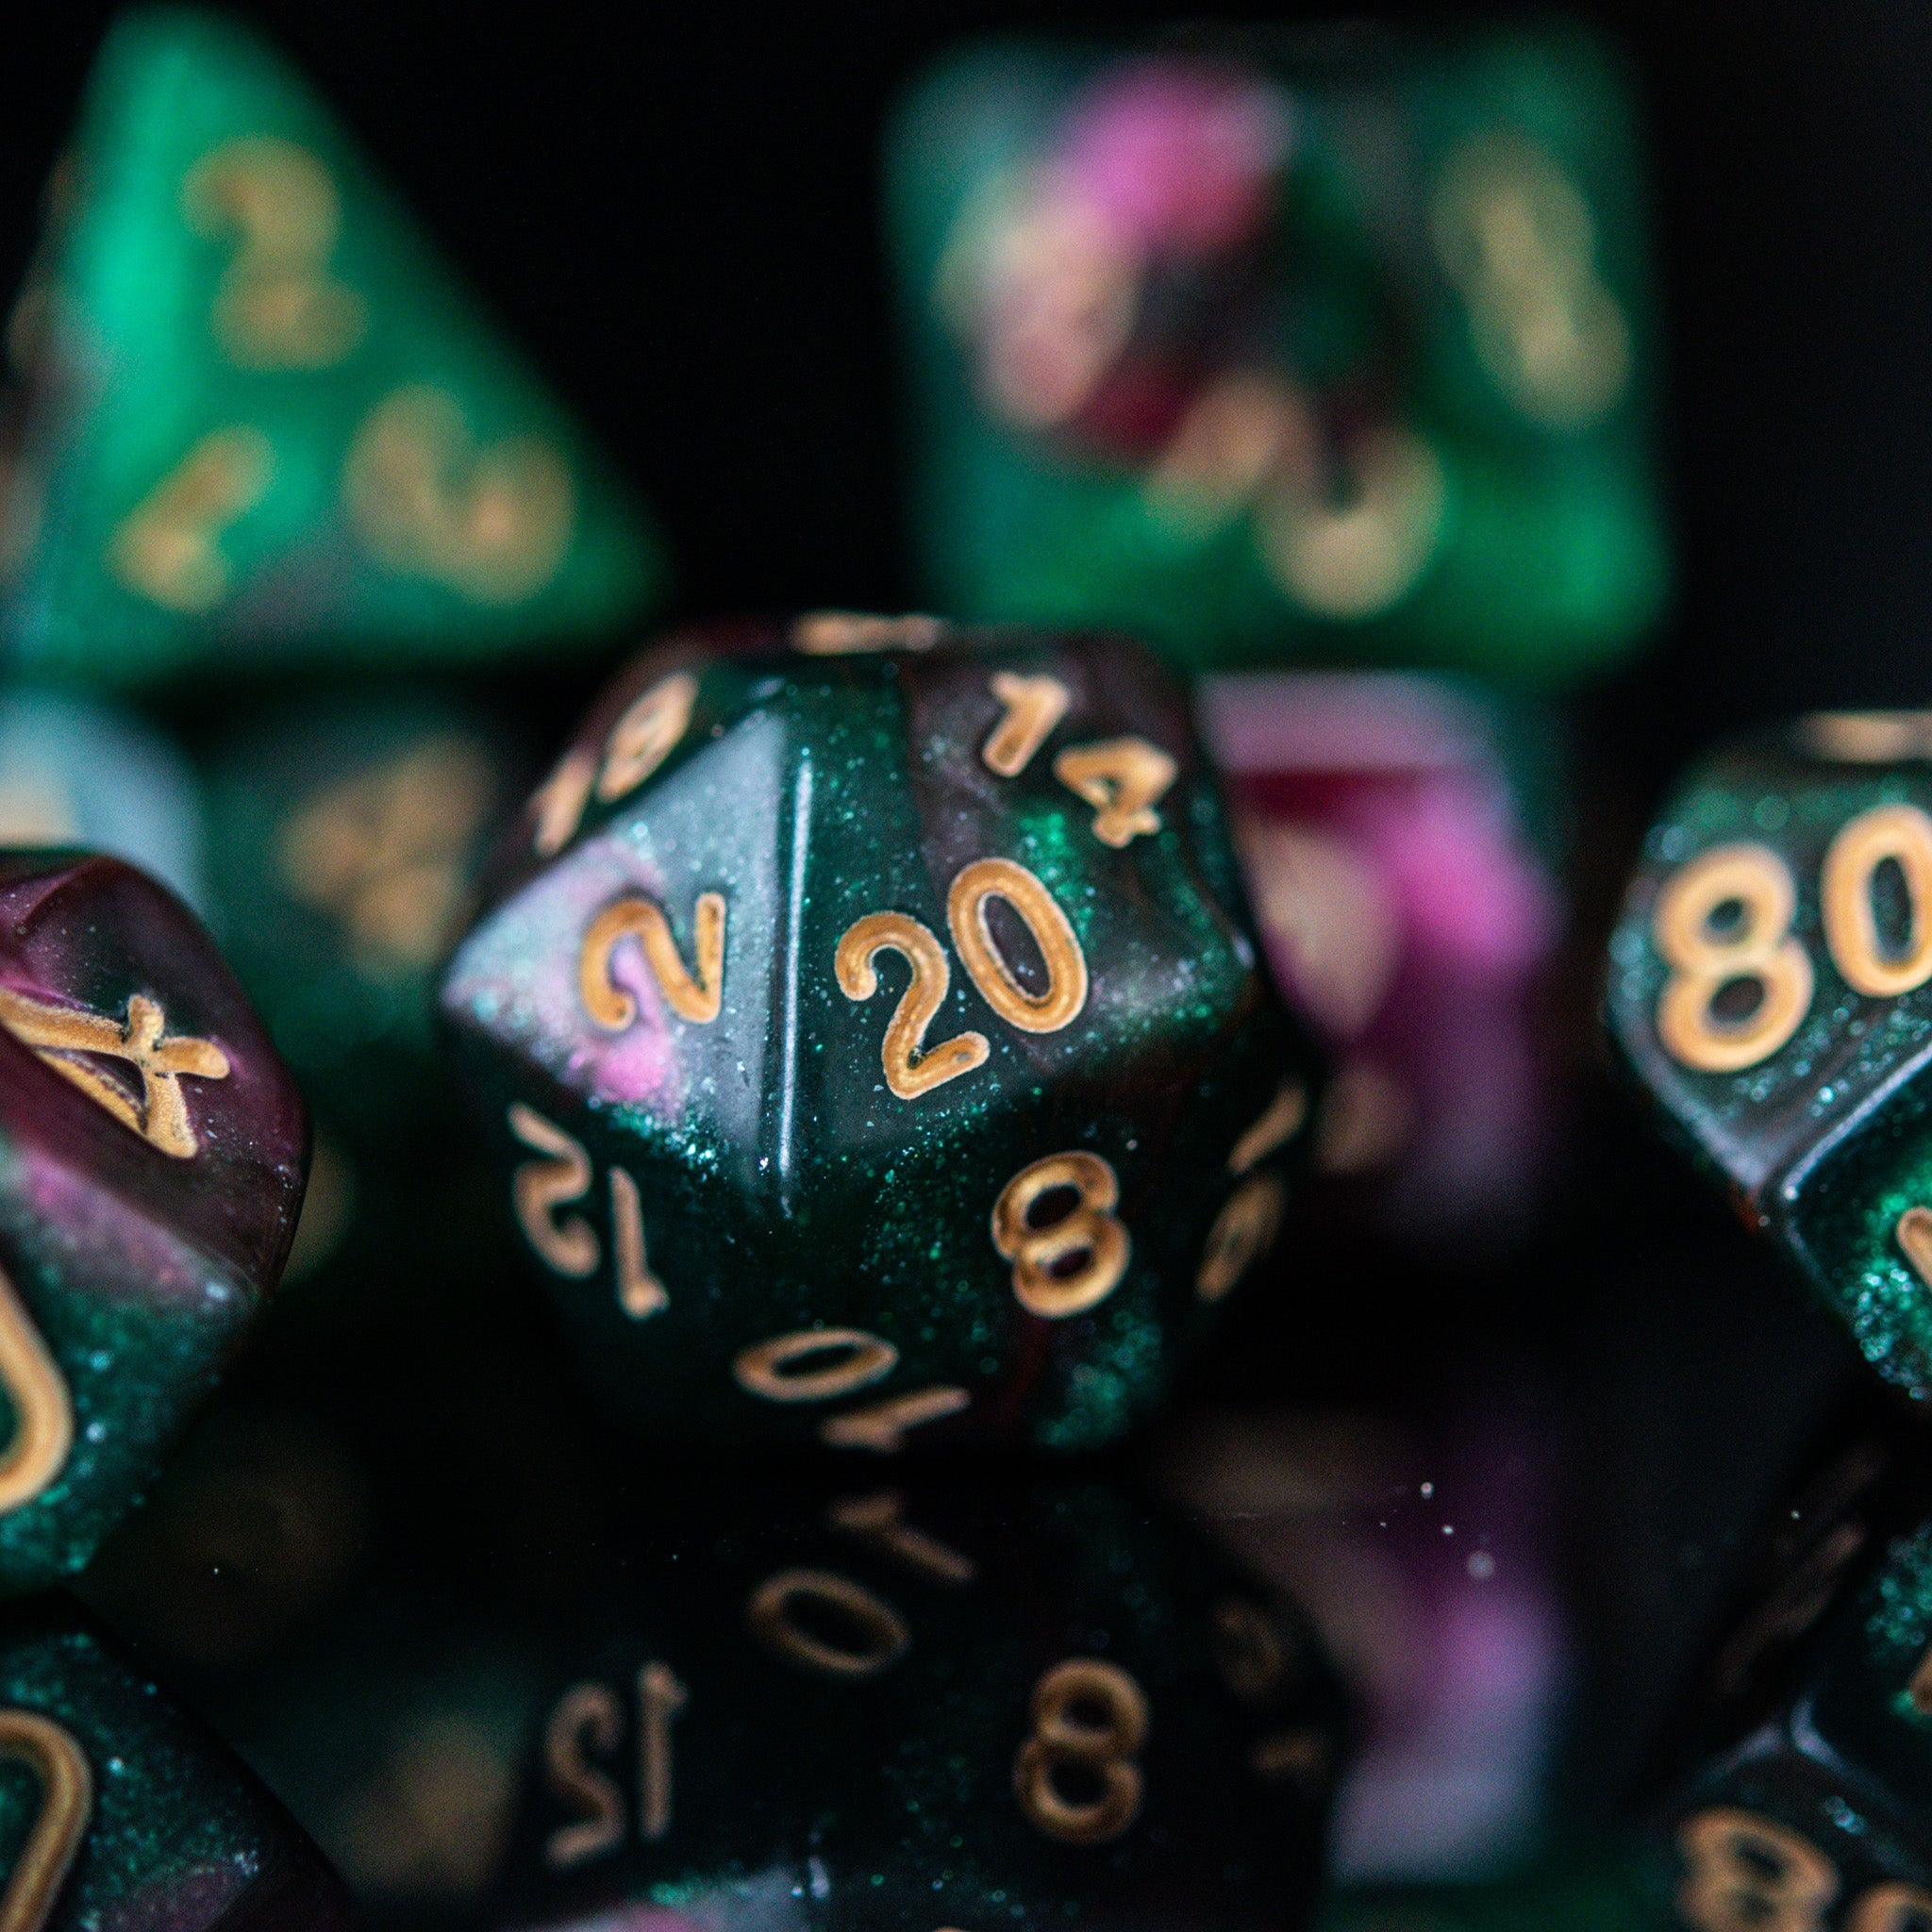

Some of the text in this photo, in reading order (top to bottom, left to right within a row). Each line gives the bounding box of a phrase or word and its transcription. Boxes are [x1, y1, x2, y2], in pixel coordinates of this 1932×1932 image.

[984, 673, 1178, 848] 14
[579, 891, 726, 1030] 2
[834, 857, 1089, 1100] 20
[1653, 804, 1932, 1073] 80
[508, 1102, 670, 1320] 12
[991, 1151, 1130, 1318] 8
[733, 1328, 971, 1450] 10
